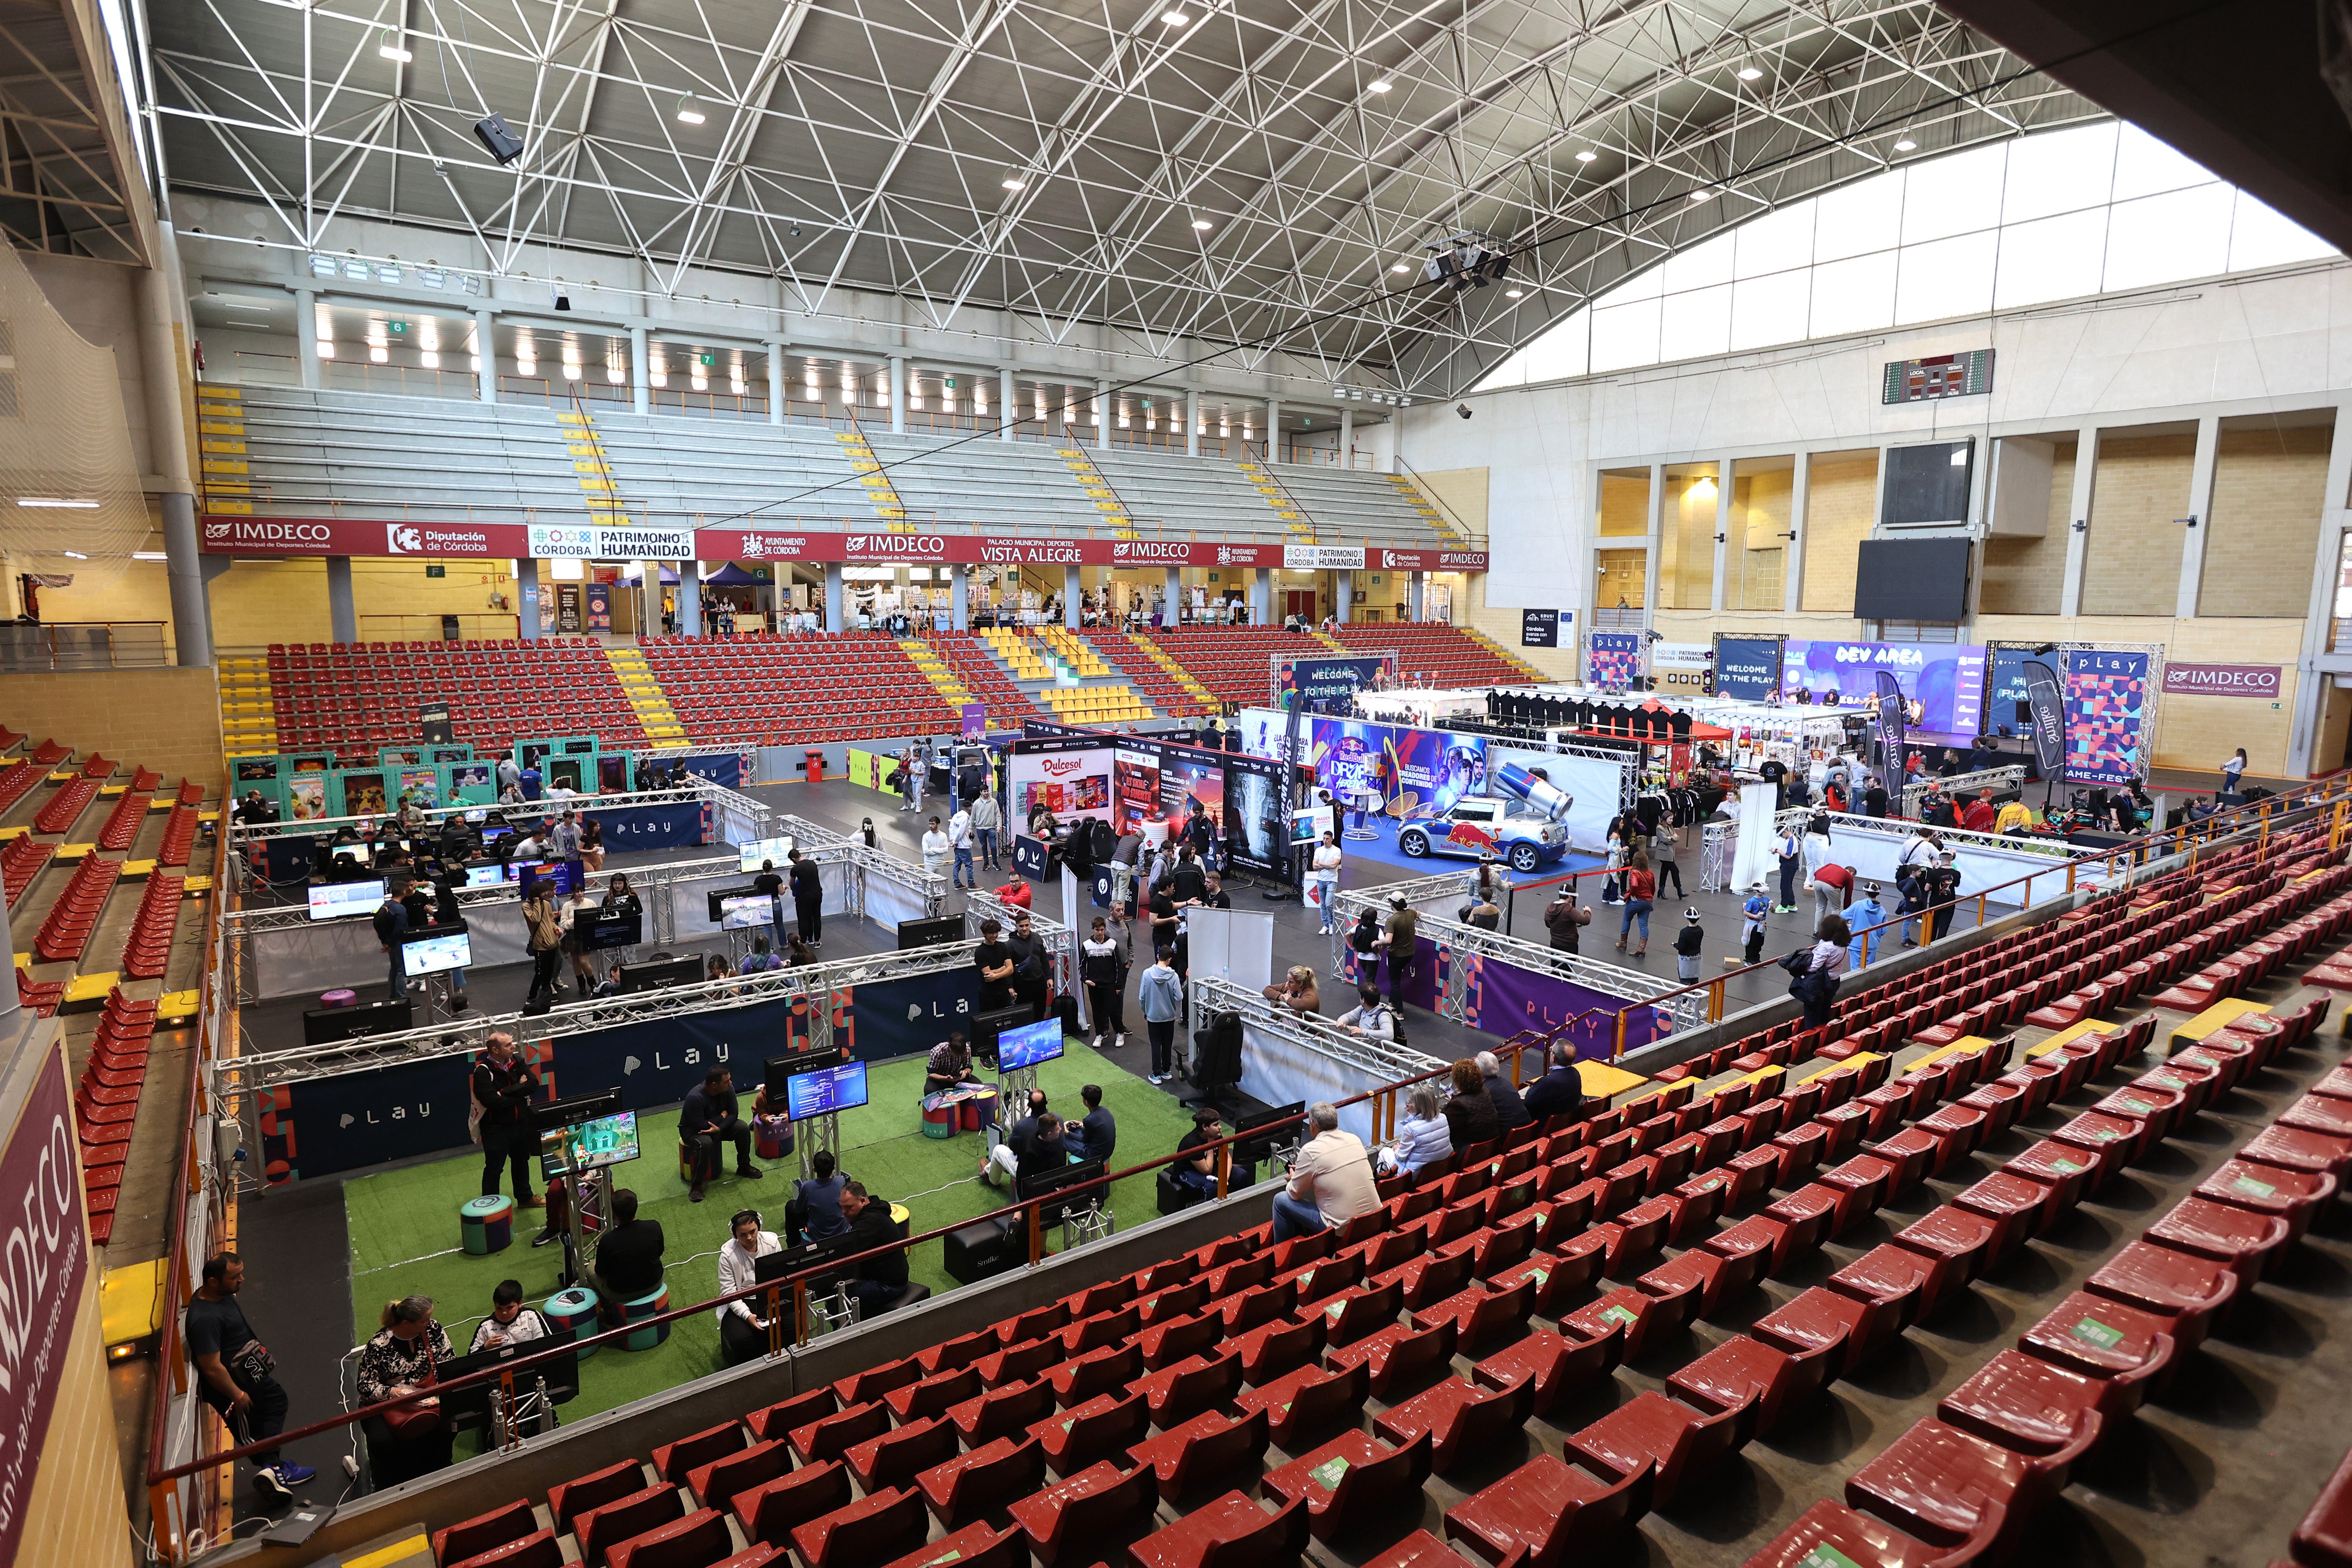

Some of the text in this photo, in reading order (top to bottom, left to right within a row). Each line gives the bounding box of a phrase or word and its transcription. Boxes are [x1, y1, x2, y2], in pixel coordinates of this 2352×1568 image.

[394, 323, 401, 332] 6
[236, 523, 330, 540] IMDECO
[426, 531, 486, 542] Diputación
[602, 532, 680, 543] PATRIMONIO
[765, 537, 806, 546] AYUNTAMIENTO
[427, 542, 487, 551] de Córdoba
[774, 545, 800, 554] CÓRDOBA
[870, 536, 944, 552] IMDECO
[1132, 542, 1189, 557] IMDECO
[535, 543, 690, 557] CÓRDOBA HUMANIDAD
[981, 547, 1082, 562] VISTA ALEGRE
[1319, 549, 1358, 557] PATRIMONIO
[1286, 558, 1363, 567] CÓRDOBA HUMANIDAD
[1451, 554, 1484, 564] IMDECO
[432, 568, 438, 576] F
[1834, 646, 1923, 665] DEV AREA
[1726, 664, 1767, 674] WELCOME
[1312, 670, 1354, 680] WELCOME
[2191, 671, 2275, 686] IMDECO
[1304, 688, 1316, 696] TO
[1318, 687, 1337, 695] THE
[1042, 758, 1082, 772] Dulcesol
[1405, 764, 1430, 774] BUSCAMOS
[1161, 775, 1185, 784] TRANSCEND
[1397, 770, 1430, 781] CREADORES
[2065, 770, 2131, 783] AME-FEST
[1402, 777, 1433, 789] CONTENIDO
[1527, 1000, 1598, 1038] PLAY
[34, 1292, 61, 1391] Deportes
[60, 1225, 79, 1298] Córdoba
